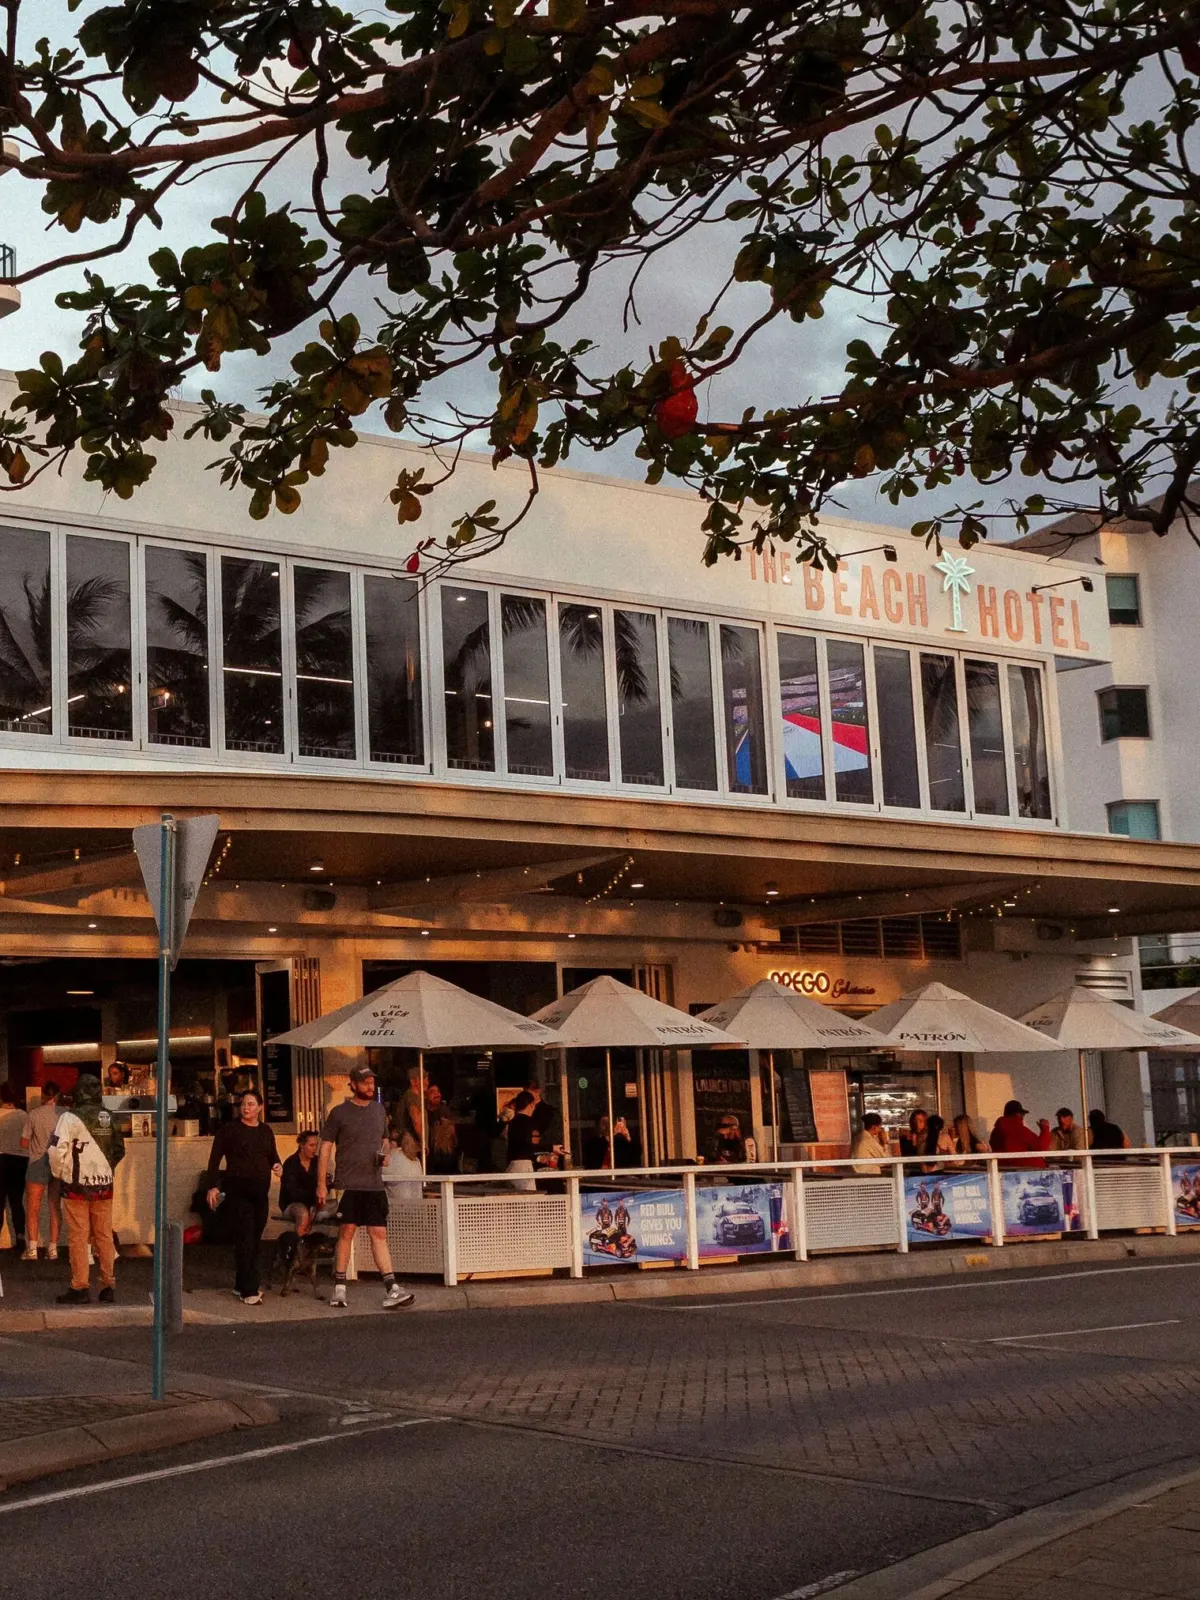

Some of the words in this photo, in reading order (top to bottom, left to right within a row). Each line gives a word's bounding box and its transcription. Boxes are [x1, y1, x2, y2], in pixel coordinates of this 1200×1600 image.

[746, 545, 793, 586] THE
[803, 558, 929, 628] BEACH
[977, 584, 1090, 651] HOTEL
[372, 1010, 410, 1018] BEACH
[817, 1026, 871, 1037] PATRÓN
[900, 1031, 967, 1041] PATRÓN
[640, 1204, 655, 1217] RED
[657, 1203, 675, 1216] BULL
[641, 1219, 663, 1231] GIVES
[664, 1217, 682, 1230] YOU
